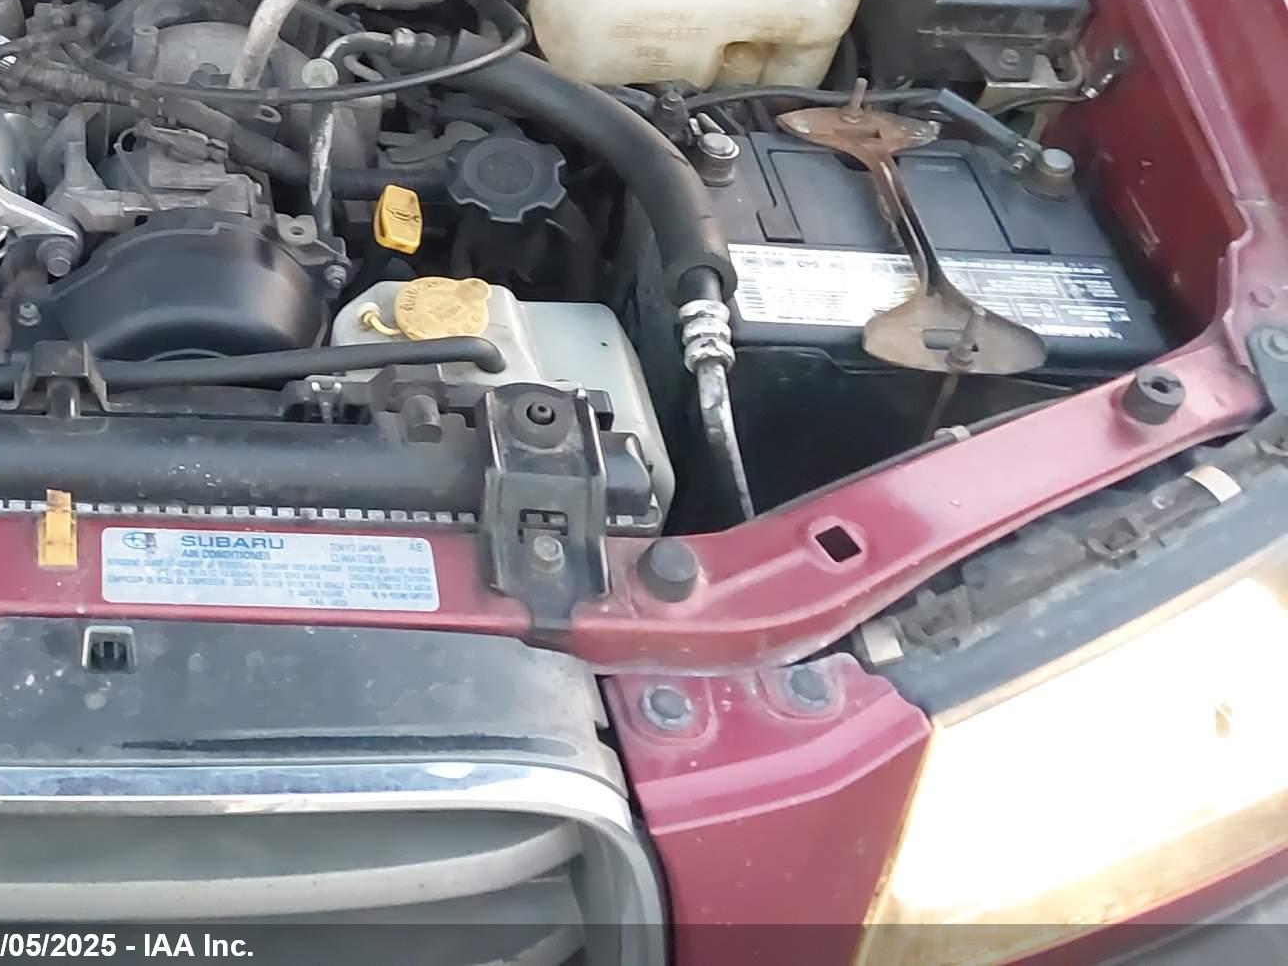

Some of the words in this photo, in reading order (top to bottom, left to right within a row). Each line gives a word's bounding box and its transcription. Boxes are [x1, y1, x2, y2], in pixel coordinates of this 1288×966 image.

[180, 535, 285, 550] SUBARU
[409, 542, 424, 553] AE
[182, 549, 201, 558] AIR
[202, 549, 271, 560] CONDITIONER
